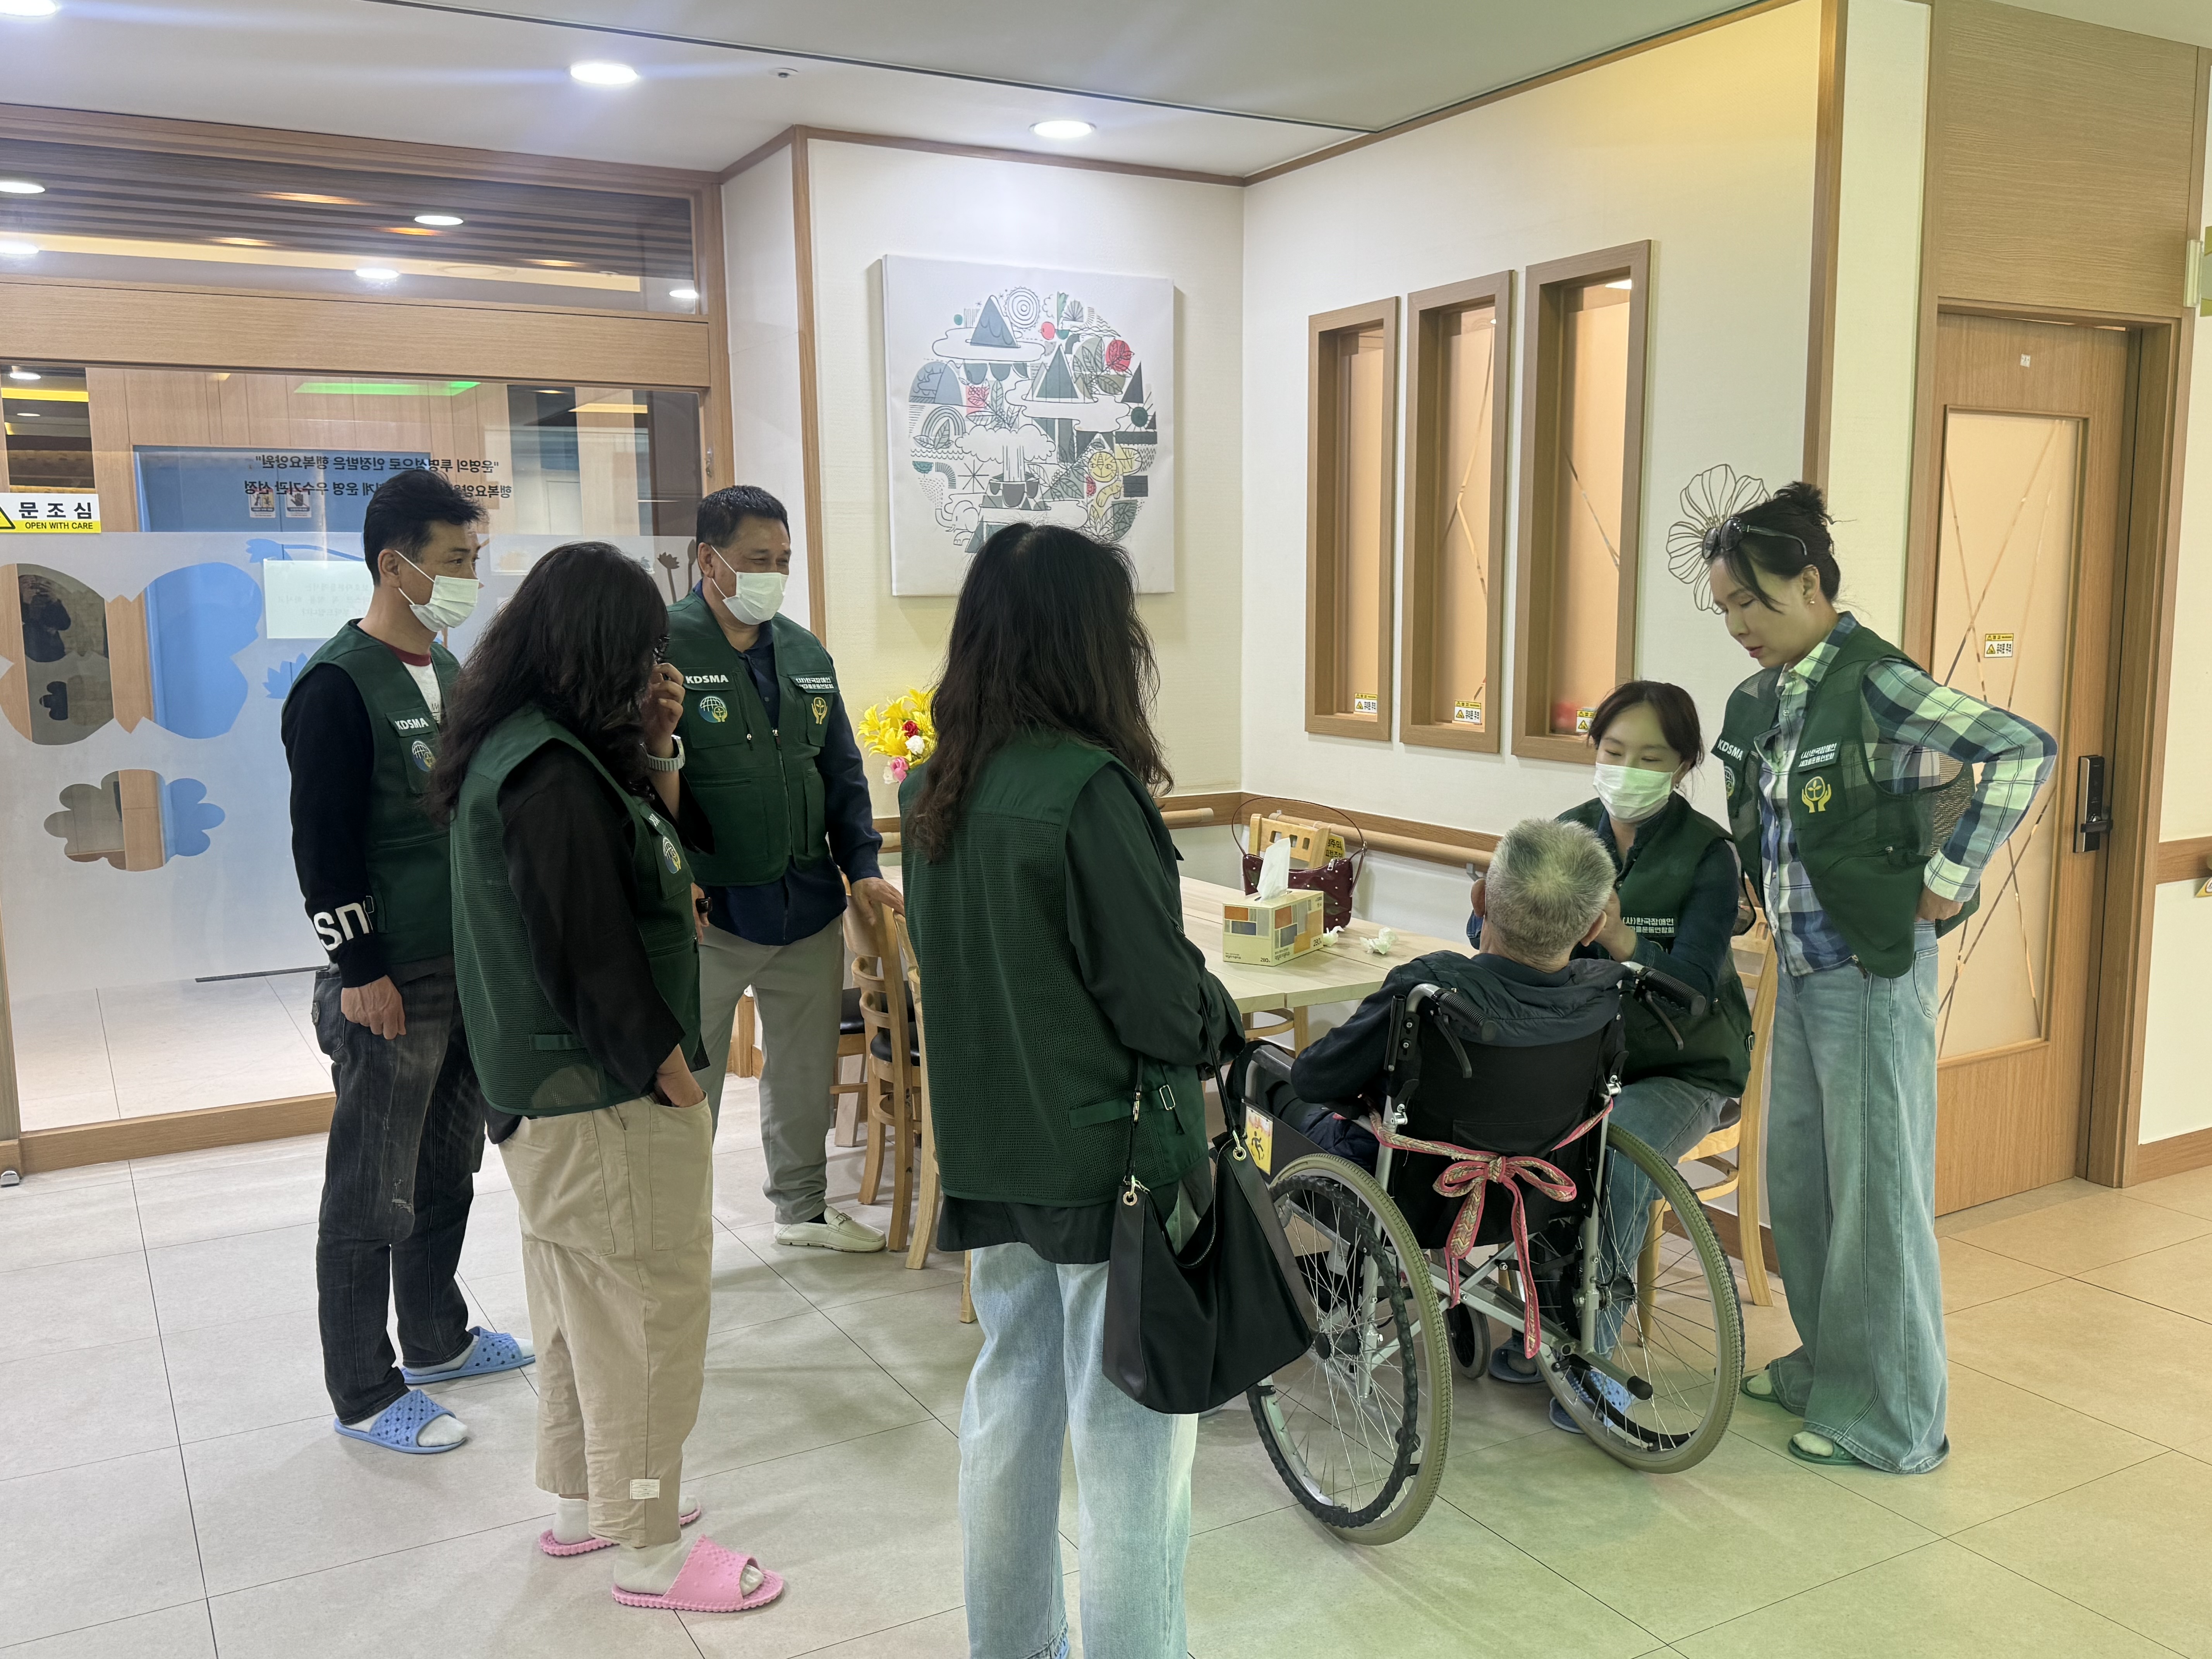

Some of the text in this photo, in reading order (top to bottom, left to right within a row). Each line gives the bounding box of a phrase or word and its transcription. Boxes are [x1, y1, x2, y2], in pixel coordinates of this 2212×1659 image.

[685, 674, 728, 684] KDSMA
[395, 718, 429, 730] KDSMA
[1717, 739, 1743, 761] KDSMA
[1623, 917, 1674, 926] (사)한국장애인
